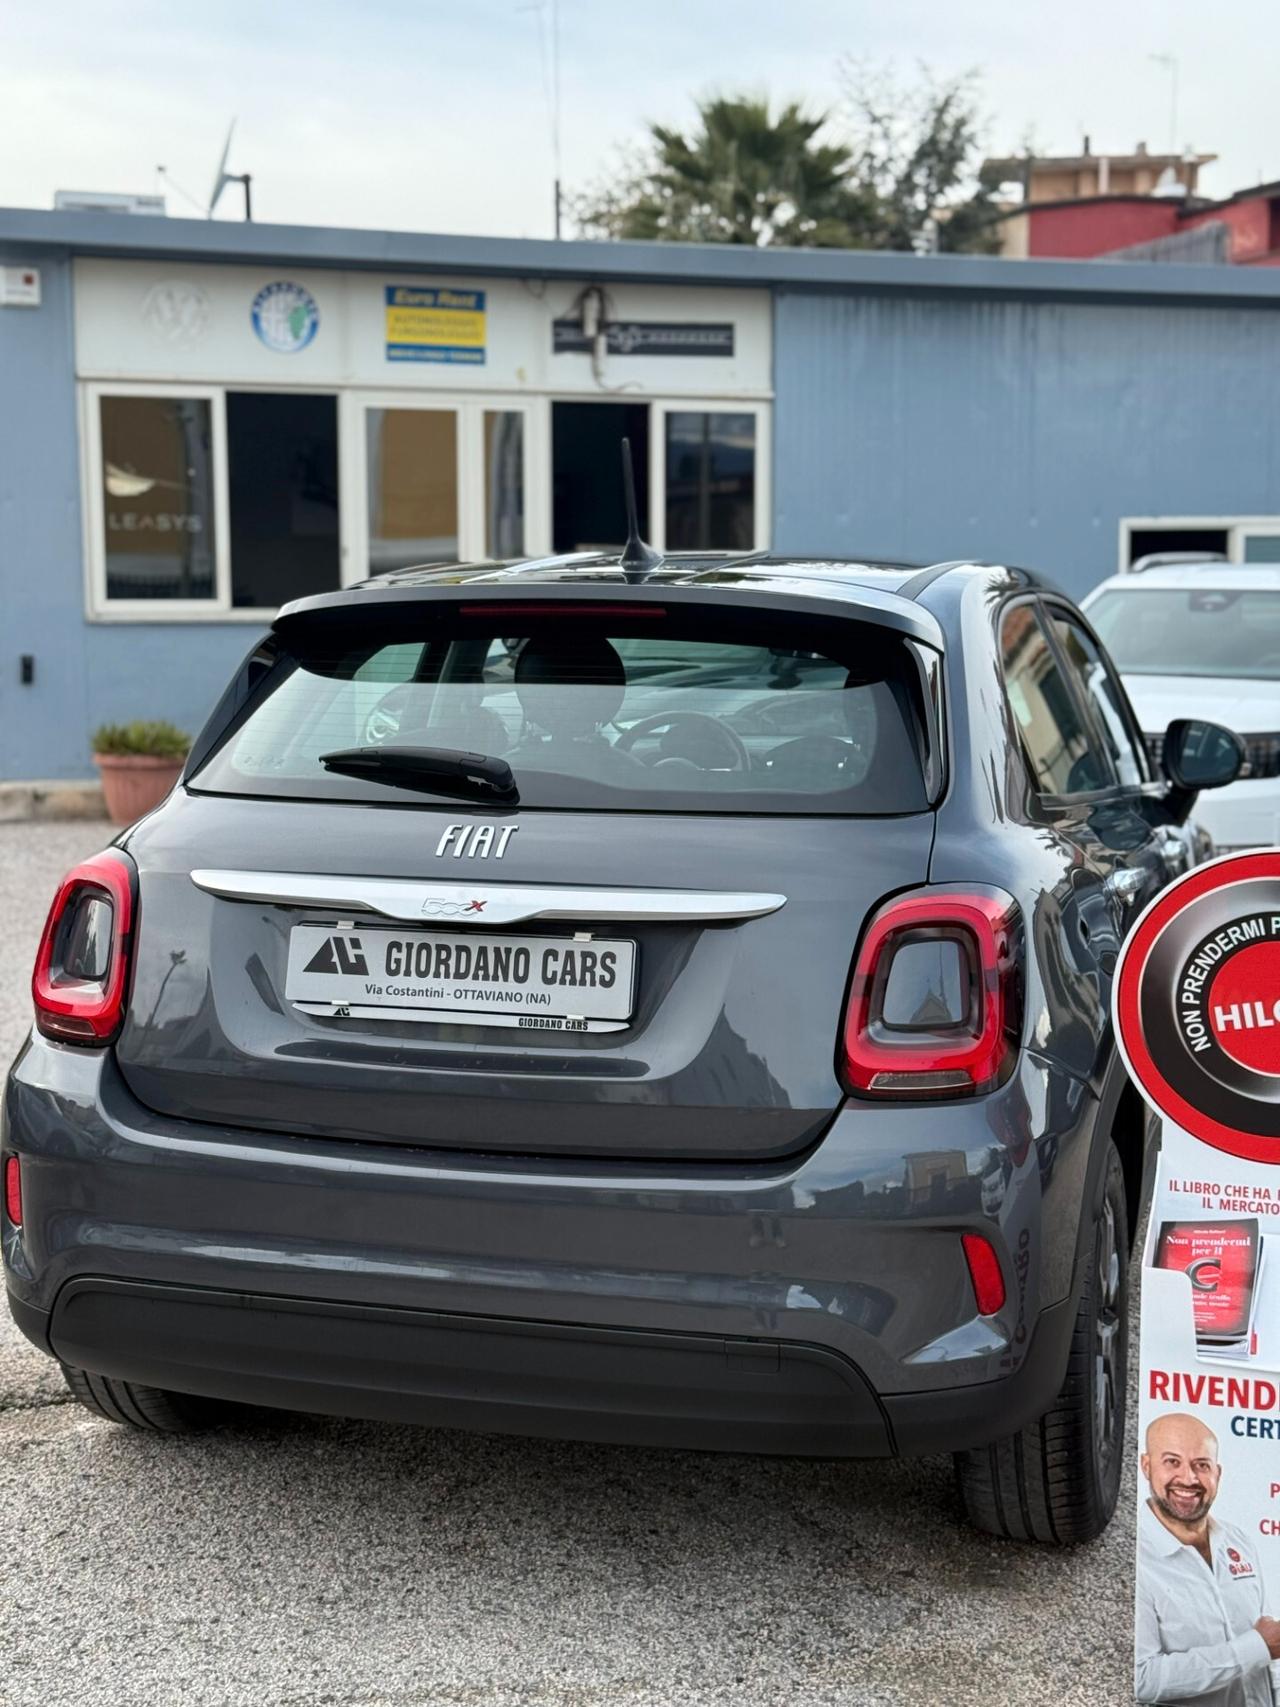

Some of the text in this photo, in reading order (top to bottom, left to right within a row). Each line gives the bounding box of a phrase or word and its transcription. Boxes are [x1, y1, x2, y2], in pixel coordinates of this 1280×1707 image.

[109, 512, 202, 532] LEASYS
[435, 825, 519, 859] FIAT
[385, 941, 617, 988] GIORDANO CARS
[1182, 918, 1266, 1004] PRENDERMI
[365, 984, 383, 995] Via
[386, 985, 444, 998] Costantini
[453, 988, 523, 1003] OTTAVIANO
[526, 992, 551, 1005] (NA)
[518, 1017, 588, 1031] GIORDANO CARS
[1182, 1010, 1211, 1052] NON
[1169, 1180, 1180, 1192] IL
[1183, 1181, 1221, 1195] LIBRO
[1224, 1185, 1249, 1198] CHE
[1253, 1187, 1271, 1200] HA
[1202, 1197, 1280, 1215] IL MERCATO
[1166, 1235, 1251, 1247] Non prendermi
[1192, 1246, 1222, 1256] per il
[1149, 1370, 1280, 1411] RIVEND
